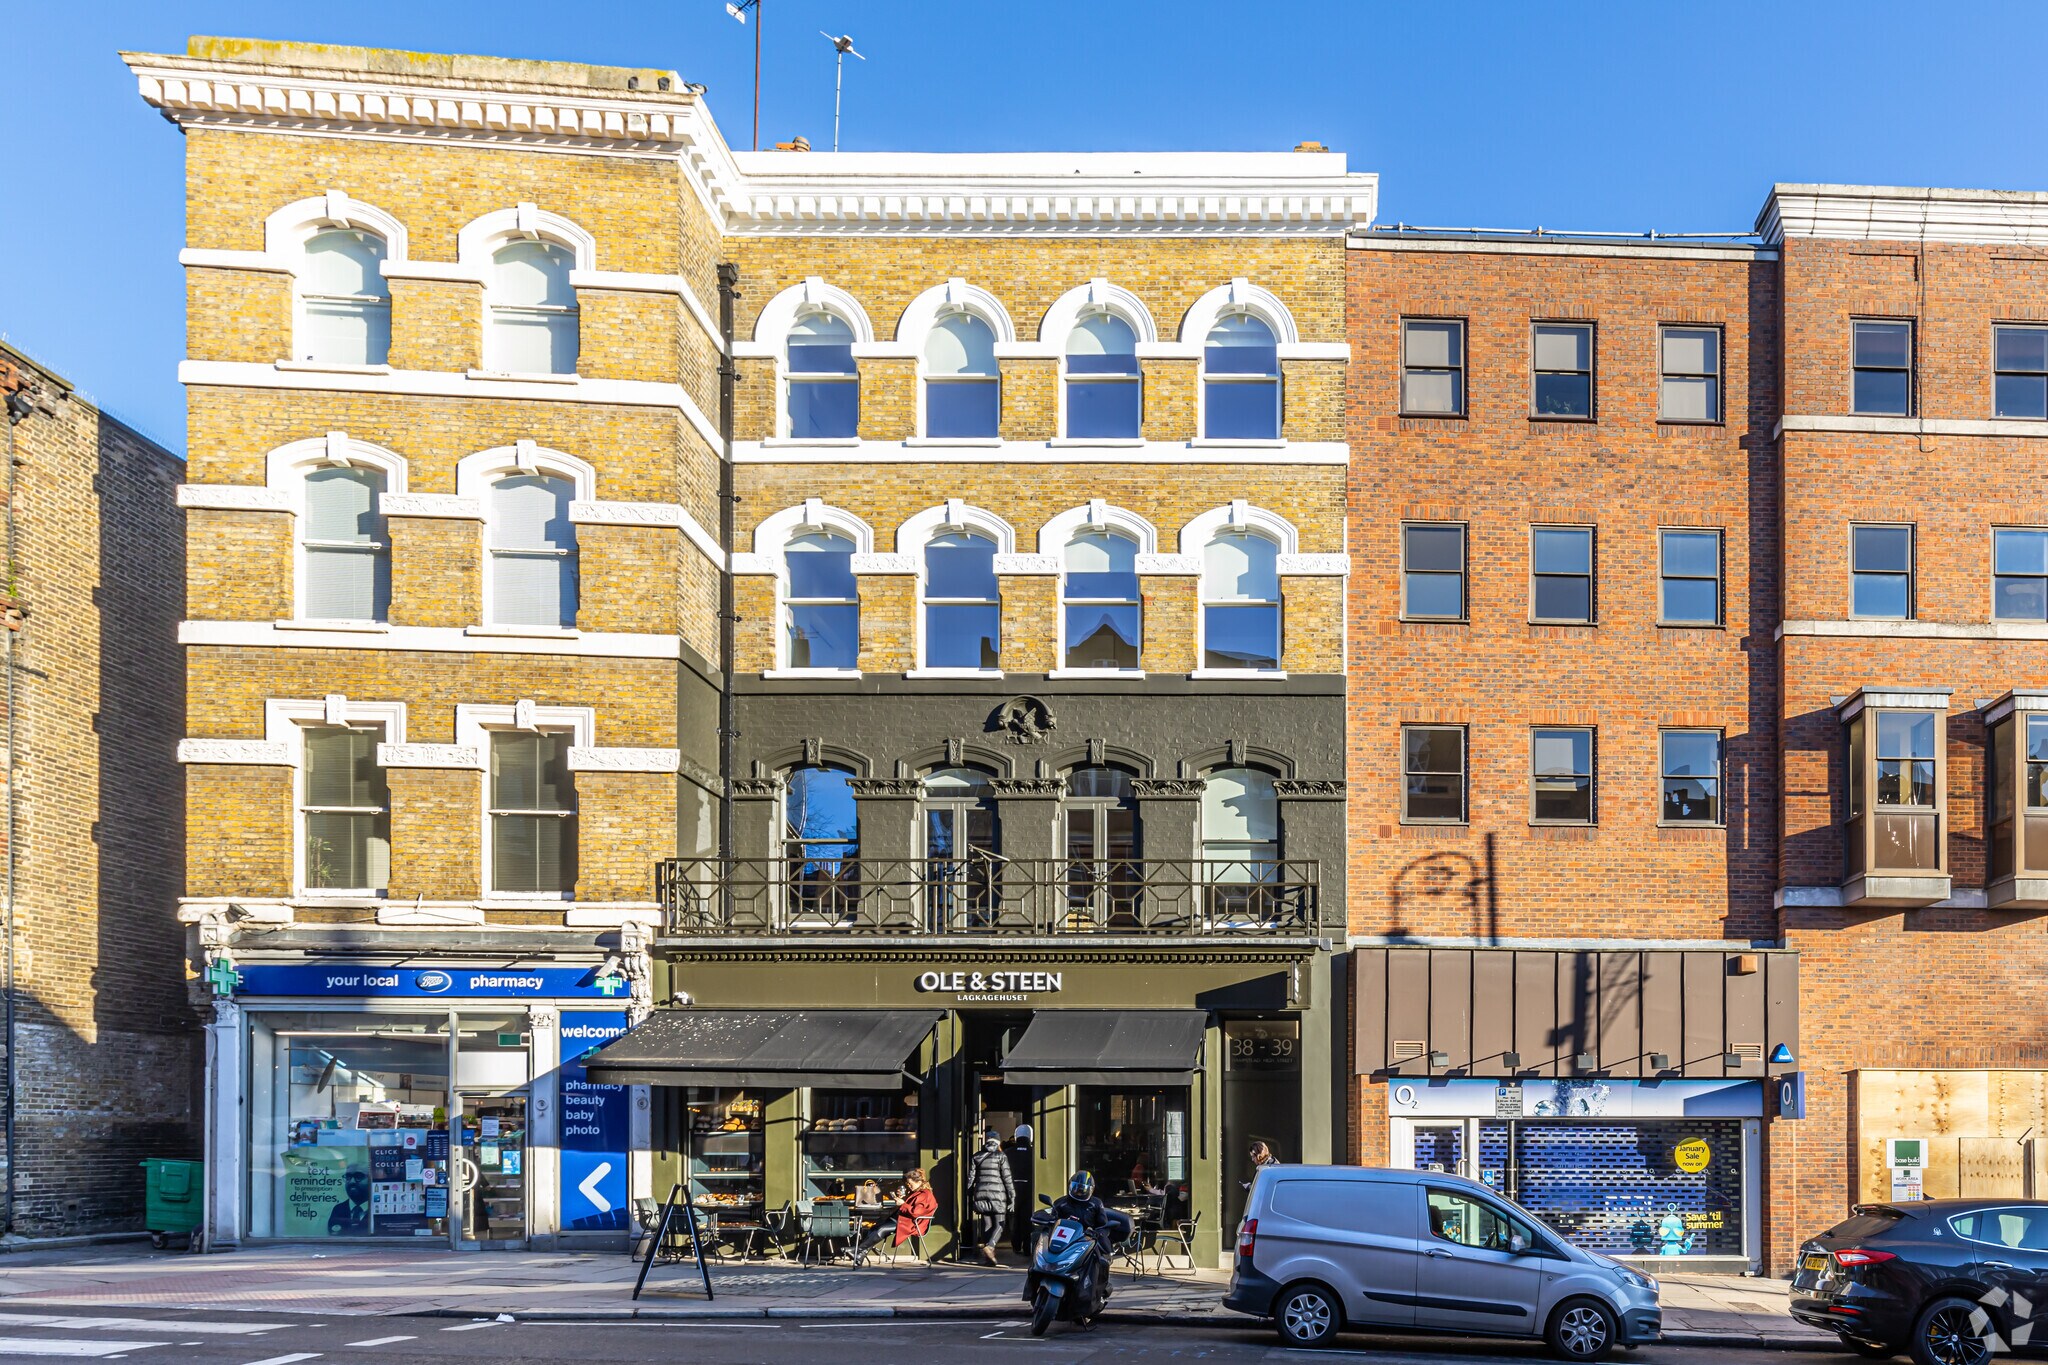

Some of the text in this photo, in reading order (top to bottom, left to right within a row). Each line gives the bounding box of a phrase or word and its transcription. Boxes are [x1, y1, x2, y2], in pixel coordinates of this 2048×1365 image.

[327, 976, 359, 988] your
[364, 974, 398, 987] local
[470, 974, 543, 990] pharmacy
[921, 971, 1062, 991] OLE & STEEN
[561, 1025, 628, 1038] welcome
[1232, 1038, 1254, 1056] 38
[1271, 1038, 1293, 1056] 39
[566, 1080, 624, 1092] pharmacy
[566, 1095, 605, 1107] beauty
[1395, 1085, 1419, 1109] O2
[1783, 1082, 1794, 1110] O2
[566, 1110, 594, 1121] baby
[566, 1125, 600, 1136] photo
[308, 1166, 330, 1176] text
[290, 1176, 342, 1186] reminders
[289, 1192, 340, 1203] deliveries,
[296, 1207, 317, 1220] help
[1685, 1212, 1708, 1221] Save
[1686, 1221, 1723, 1229] summer
[1057, 1228, 1067, 1238] L
